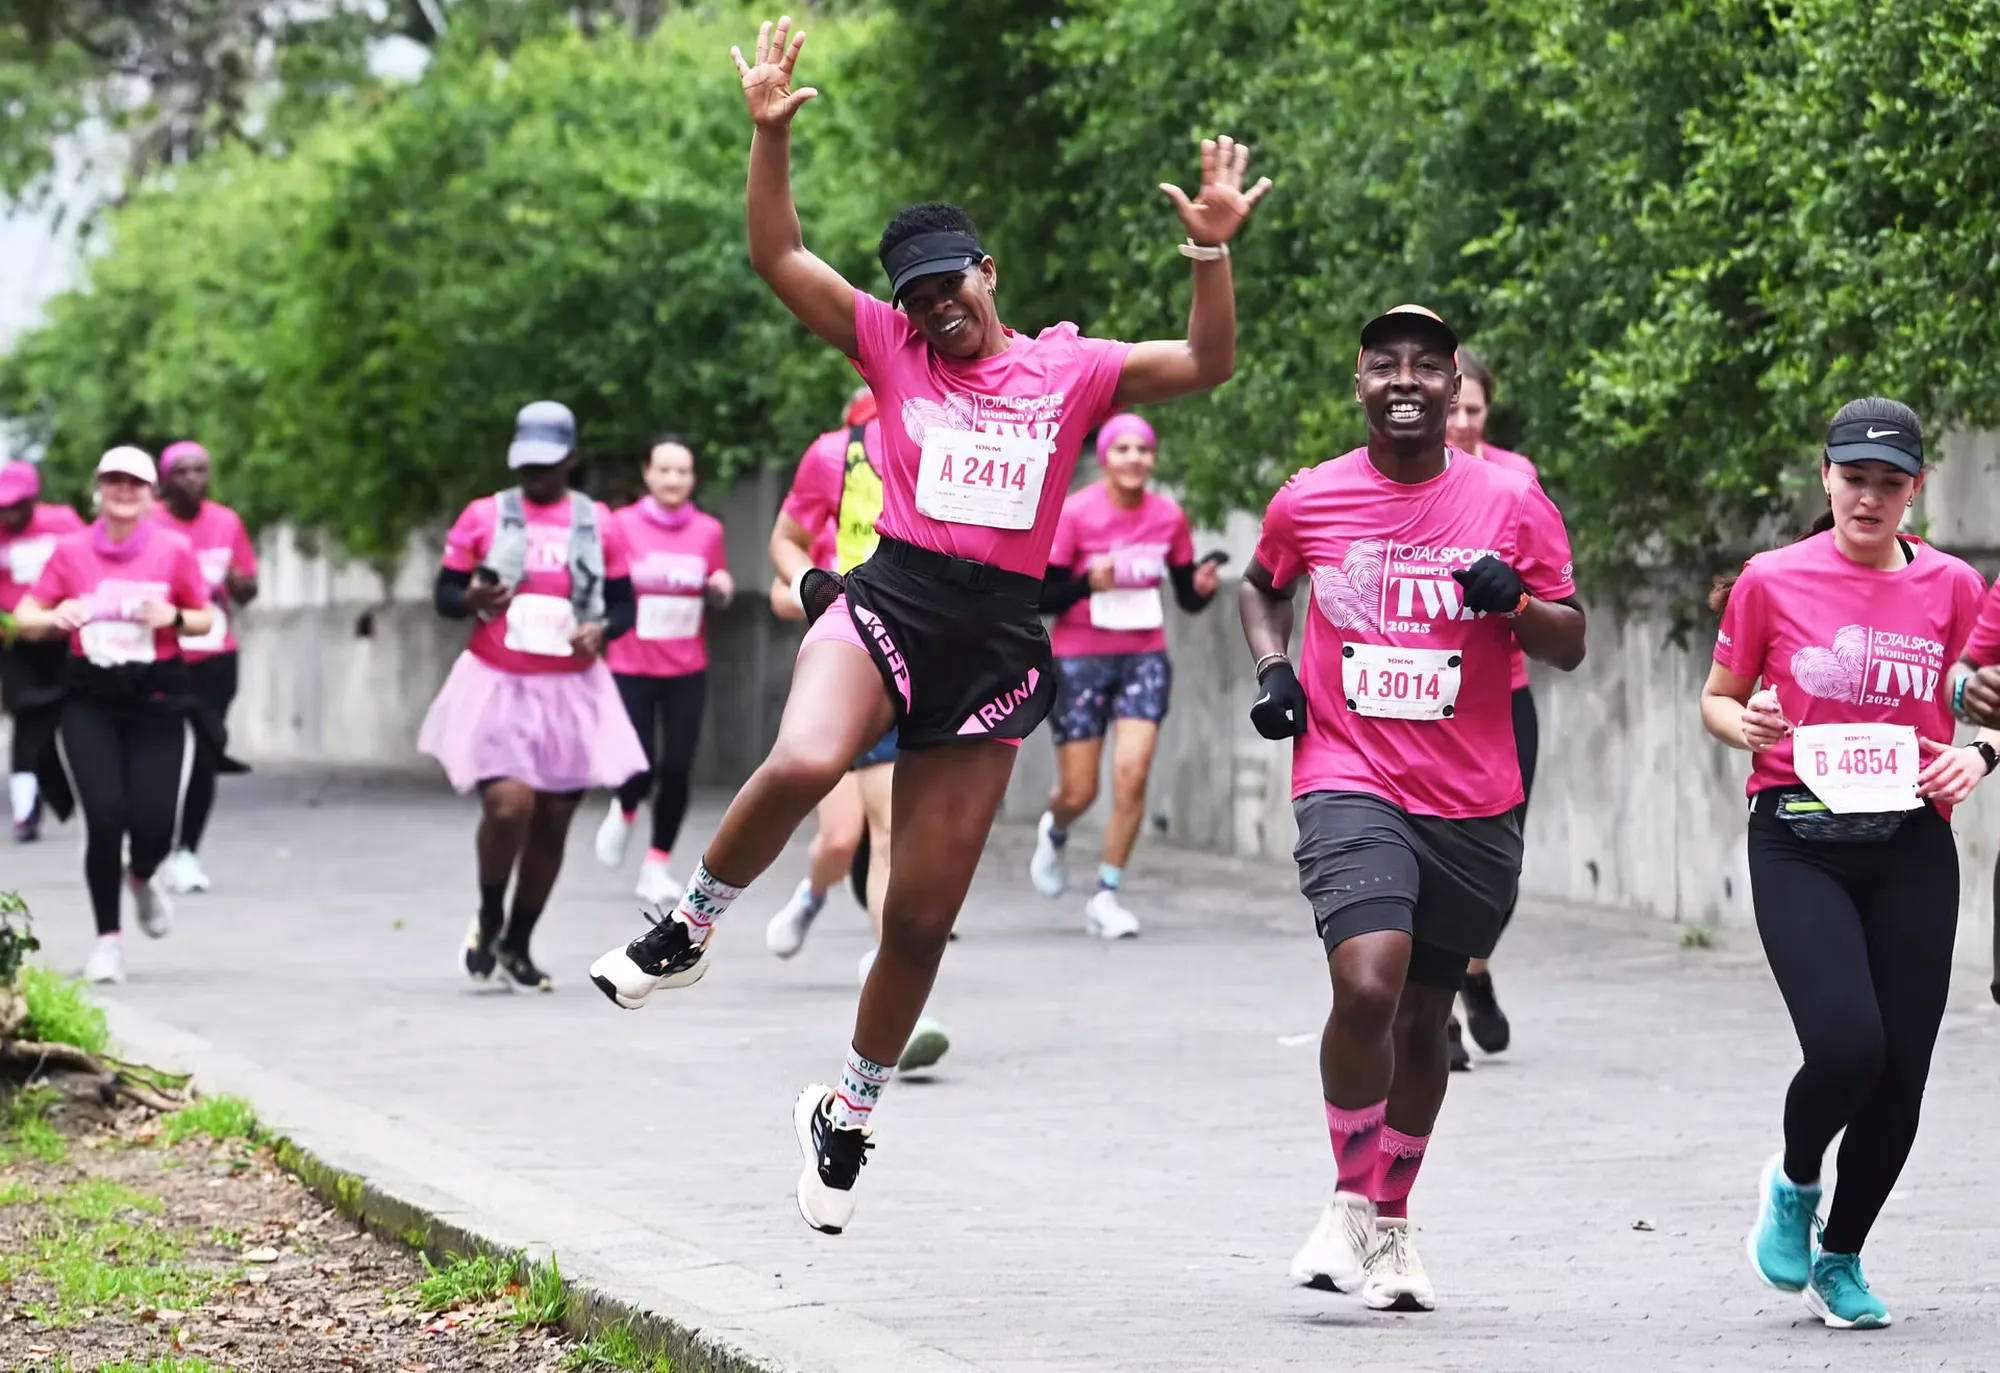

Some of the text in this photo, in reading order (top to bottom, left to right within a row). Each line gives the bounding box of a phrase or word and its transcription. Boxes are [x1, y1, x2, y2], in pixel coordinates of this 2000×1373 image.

[978, 392, 1064, 411] TOTALSPORTS
[940, 454, 1026, 490] A 2414
[1393, 561, 1456, 577] Women'
[1387, 621, 1431, 634] 2025
[866, 616, 907, 681] KEEP
[1874, 645, 1927, 664] Women's
[1357, 669, 1440, 700] A 3014
[1870, 658, 1939, 704] TWR
[978, 681, 1029, 729] RUN
[1865, 694, 1900, 708] 2025
[1815, 748, 1898, 776] B 4854
[859, 1059, 884, 1075] OFF
